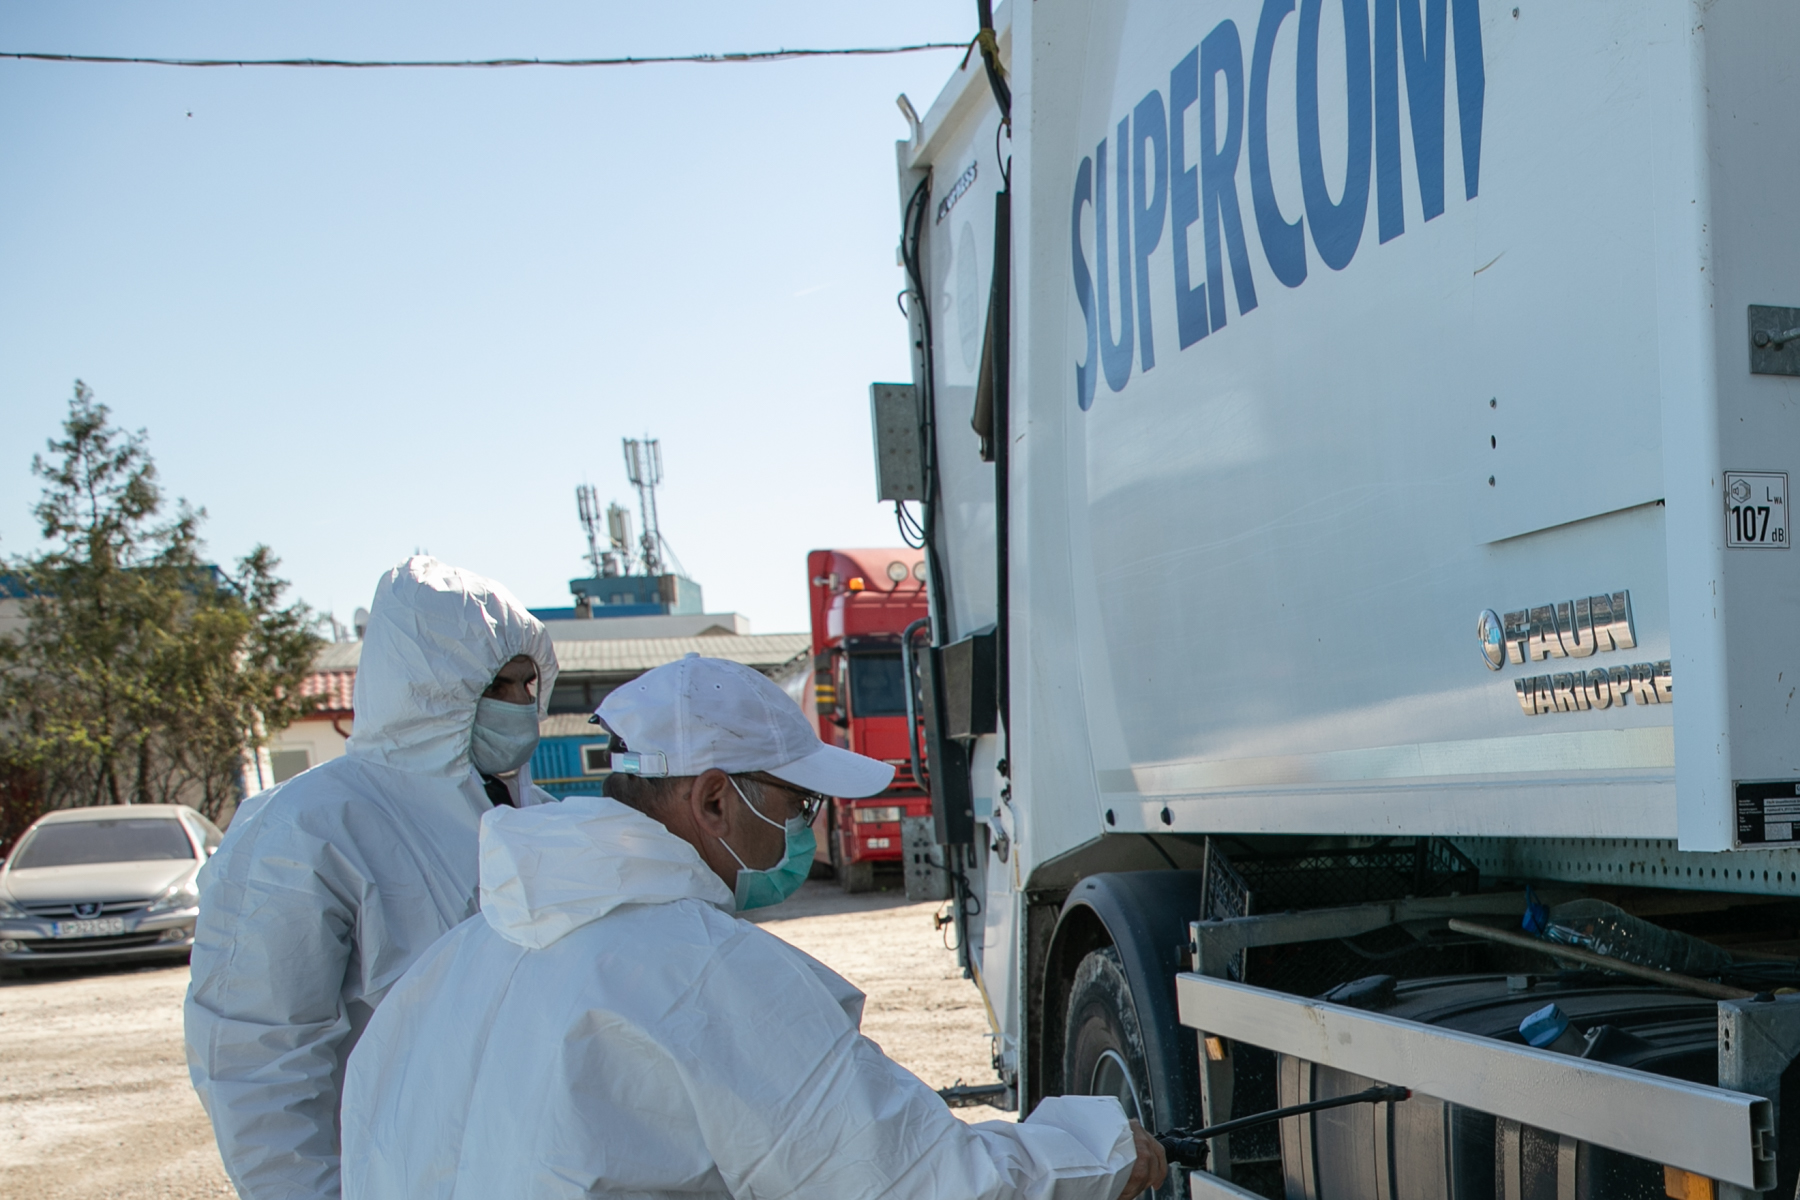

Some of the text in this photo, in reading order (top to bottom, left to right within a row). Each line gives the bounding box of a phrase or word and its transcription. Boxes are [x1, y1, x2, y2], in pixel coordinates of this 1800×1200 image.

[1072, 0, 1485, 412] SUPERCOM
[1731, 505, 1785, 542] 107 dB
[1503, 589, 1637, 664] FAUN
[1514, 660, 1673, 716] VARIOPRE
